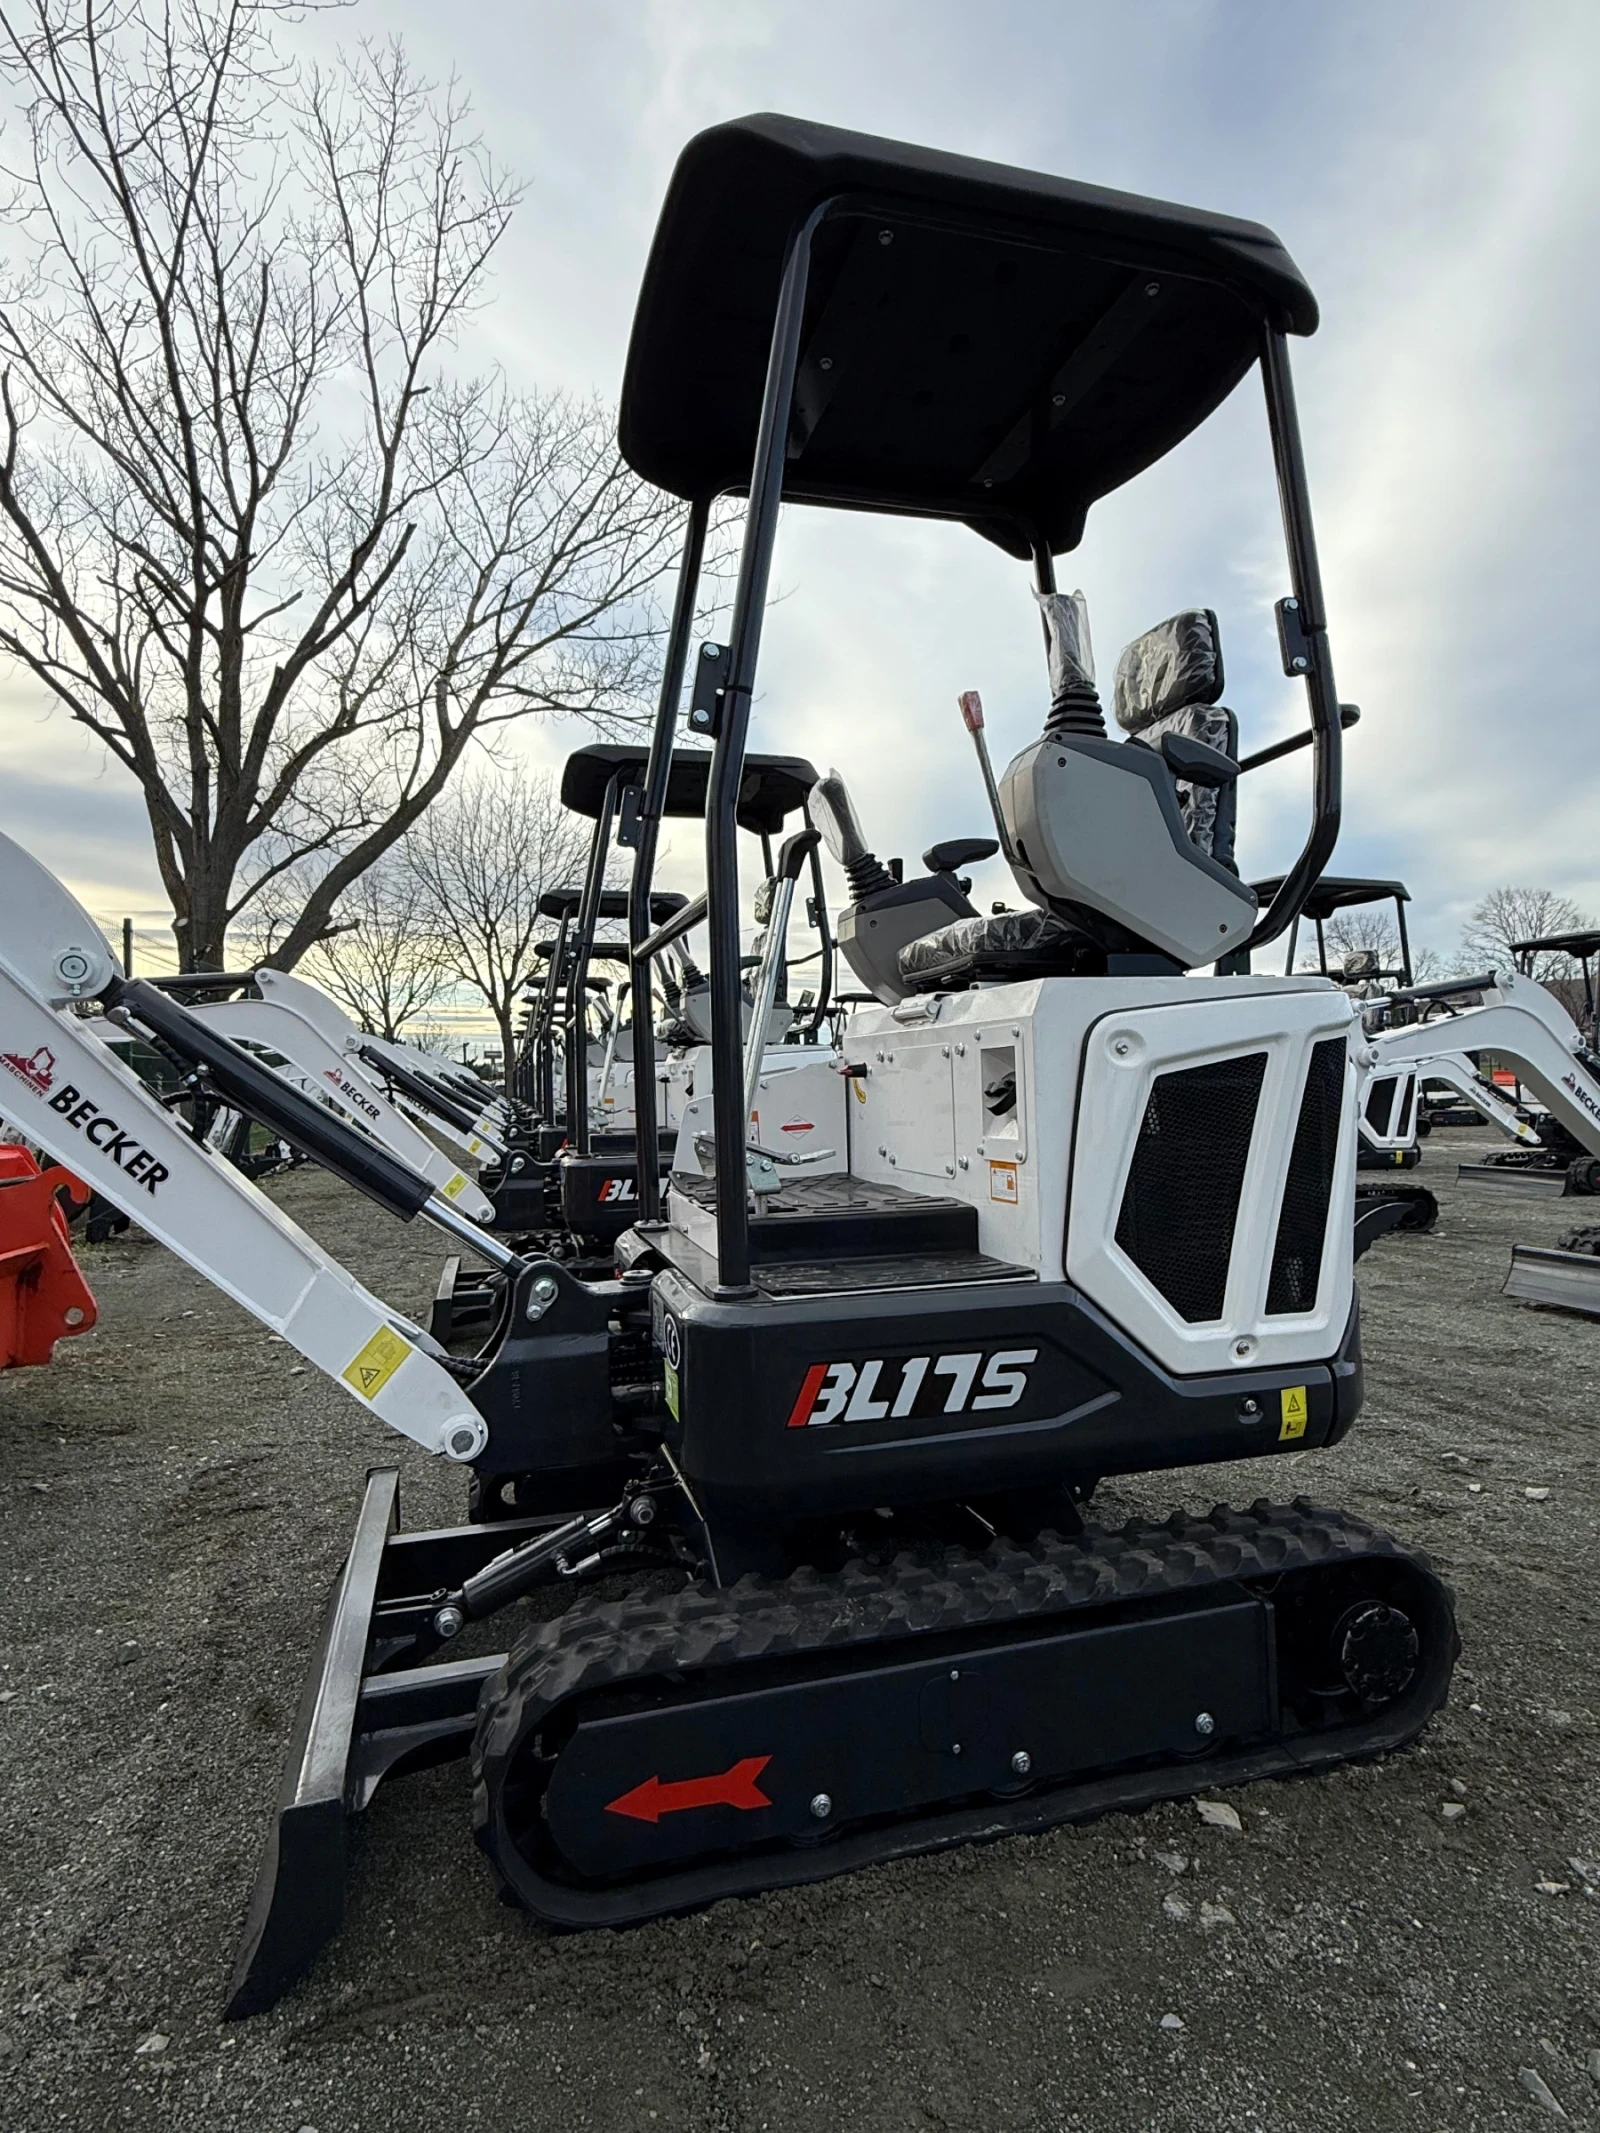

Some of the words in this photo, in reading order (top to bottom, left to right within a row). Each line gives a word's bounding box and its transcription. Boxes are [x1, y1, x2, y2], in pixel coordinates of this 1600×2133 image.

[340, 1081, 380, 1120] BECKER
[1575, 1086, 1600, 1121] BECKE
[48, 1084, 169, 1195] BECKER
[787, 1349, 1038, 1428] BL17S
